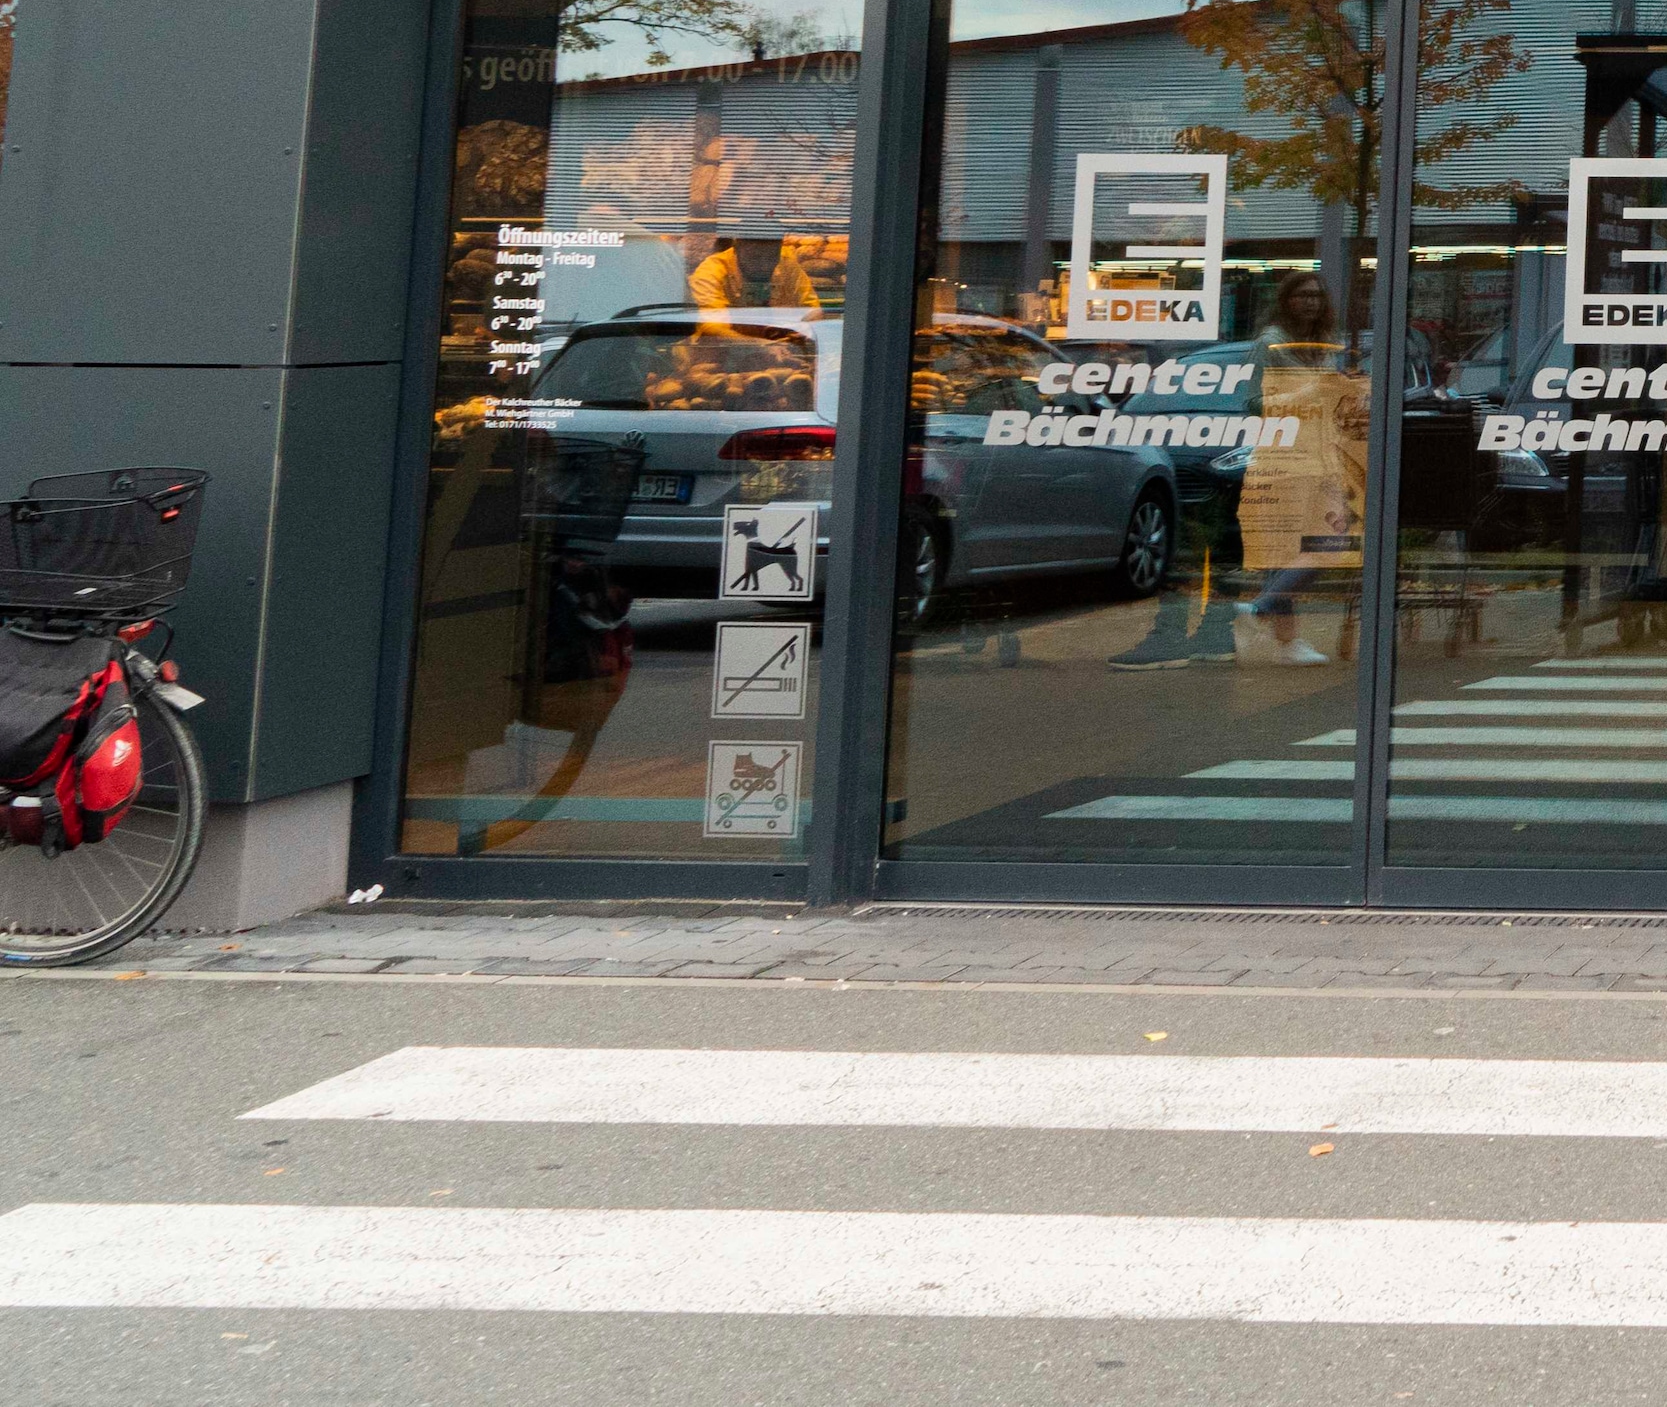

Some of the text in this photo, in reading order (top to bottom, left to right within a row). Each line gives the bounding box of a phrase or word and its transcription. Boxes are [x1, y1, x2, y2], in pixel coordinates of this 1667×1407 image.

[498, 224, 624, 248] Öffnungszeiten:
[496, 251, 596, 268] Montag Freitag
[492, 296, 545, 313] Samstag
[1086, 300, 1205, 322] EDEKA
[489, 340, 542, 356] Sonntag
[1038, 359, 1255, 395] center
[486, 398, 501, 406] Der
[982, 406, 1300, 447] Bächmann
